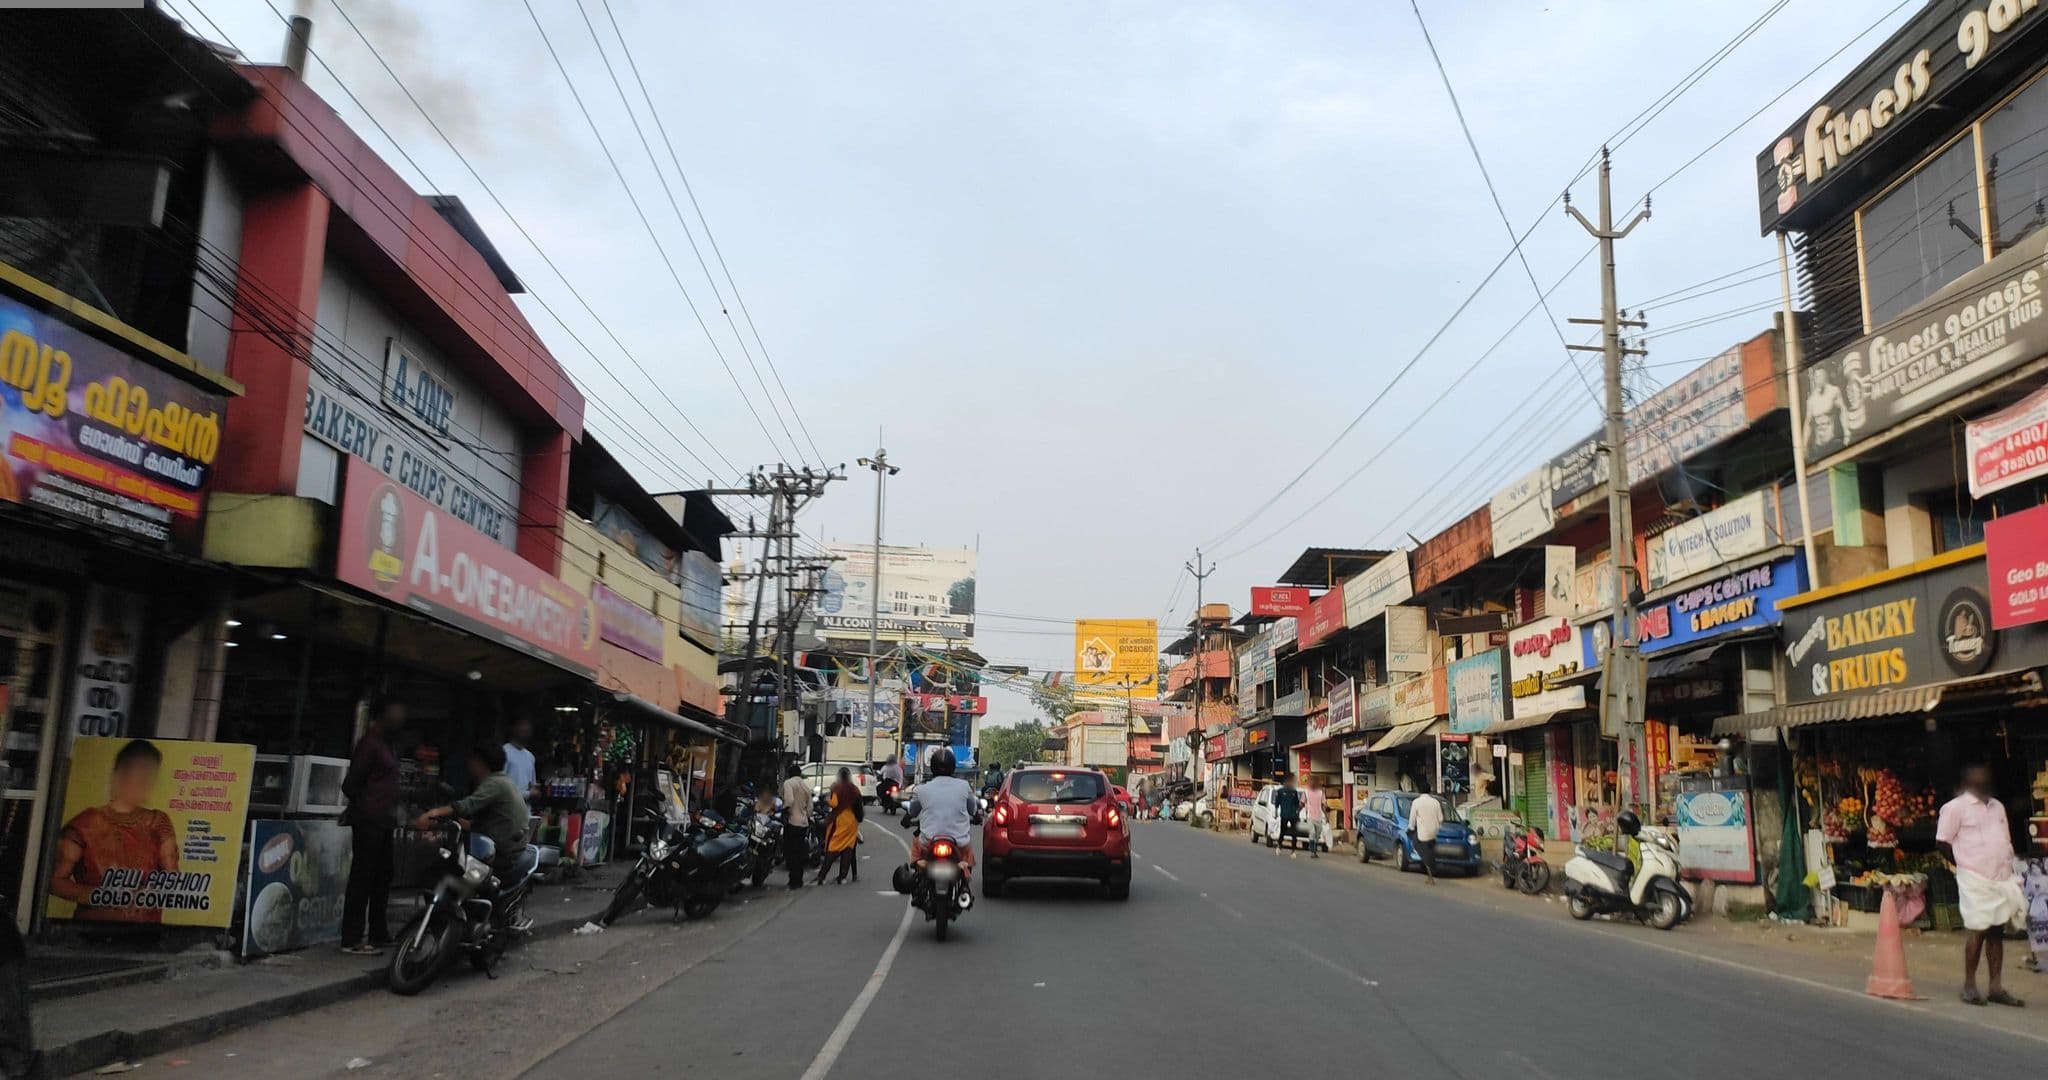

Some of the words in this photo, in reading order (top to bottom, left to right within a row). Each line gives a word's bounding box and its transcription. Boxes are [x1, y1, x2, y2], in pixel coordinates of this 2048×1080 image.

[1804, 48, 1931, 185] fitness
[1869, 322, 1940, 378] fitness
[1944, 268, 2041, 343] garage
[1908, 352, 1939, 380] GYM
[1940, 346, 1952, 365] &
[1953, 316, 2006, 358] HEALTH
[2008, 299, 2043, 330] HUB
[393, 354, 455, 434] A-ONE
[303, 386, 380, 462] BAKERY
[383, 445, 394, 474] &
[399, 449, 447, 507] CHIPS
[450, 485, 505, 541] CENTRE
[1714, 513, 1752, 541] SOLUTION
[2007, 567, 2034, 586] Geo
[2008, 586, 2038, 607] GOLD
[1826, 596, 1917, 651] BAKERY
[1812, 661, 1829, 697] &
[1829, 647, 1908, 693] FRUITS
[90, 889, 131, 909] GOLD
[135, 891, 211, 911] COVERING
[101, 867, 145, 889] NEW
[145, 869, 212, 893] FASHION
